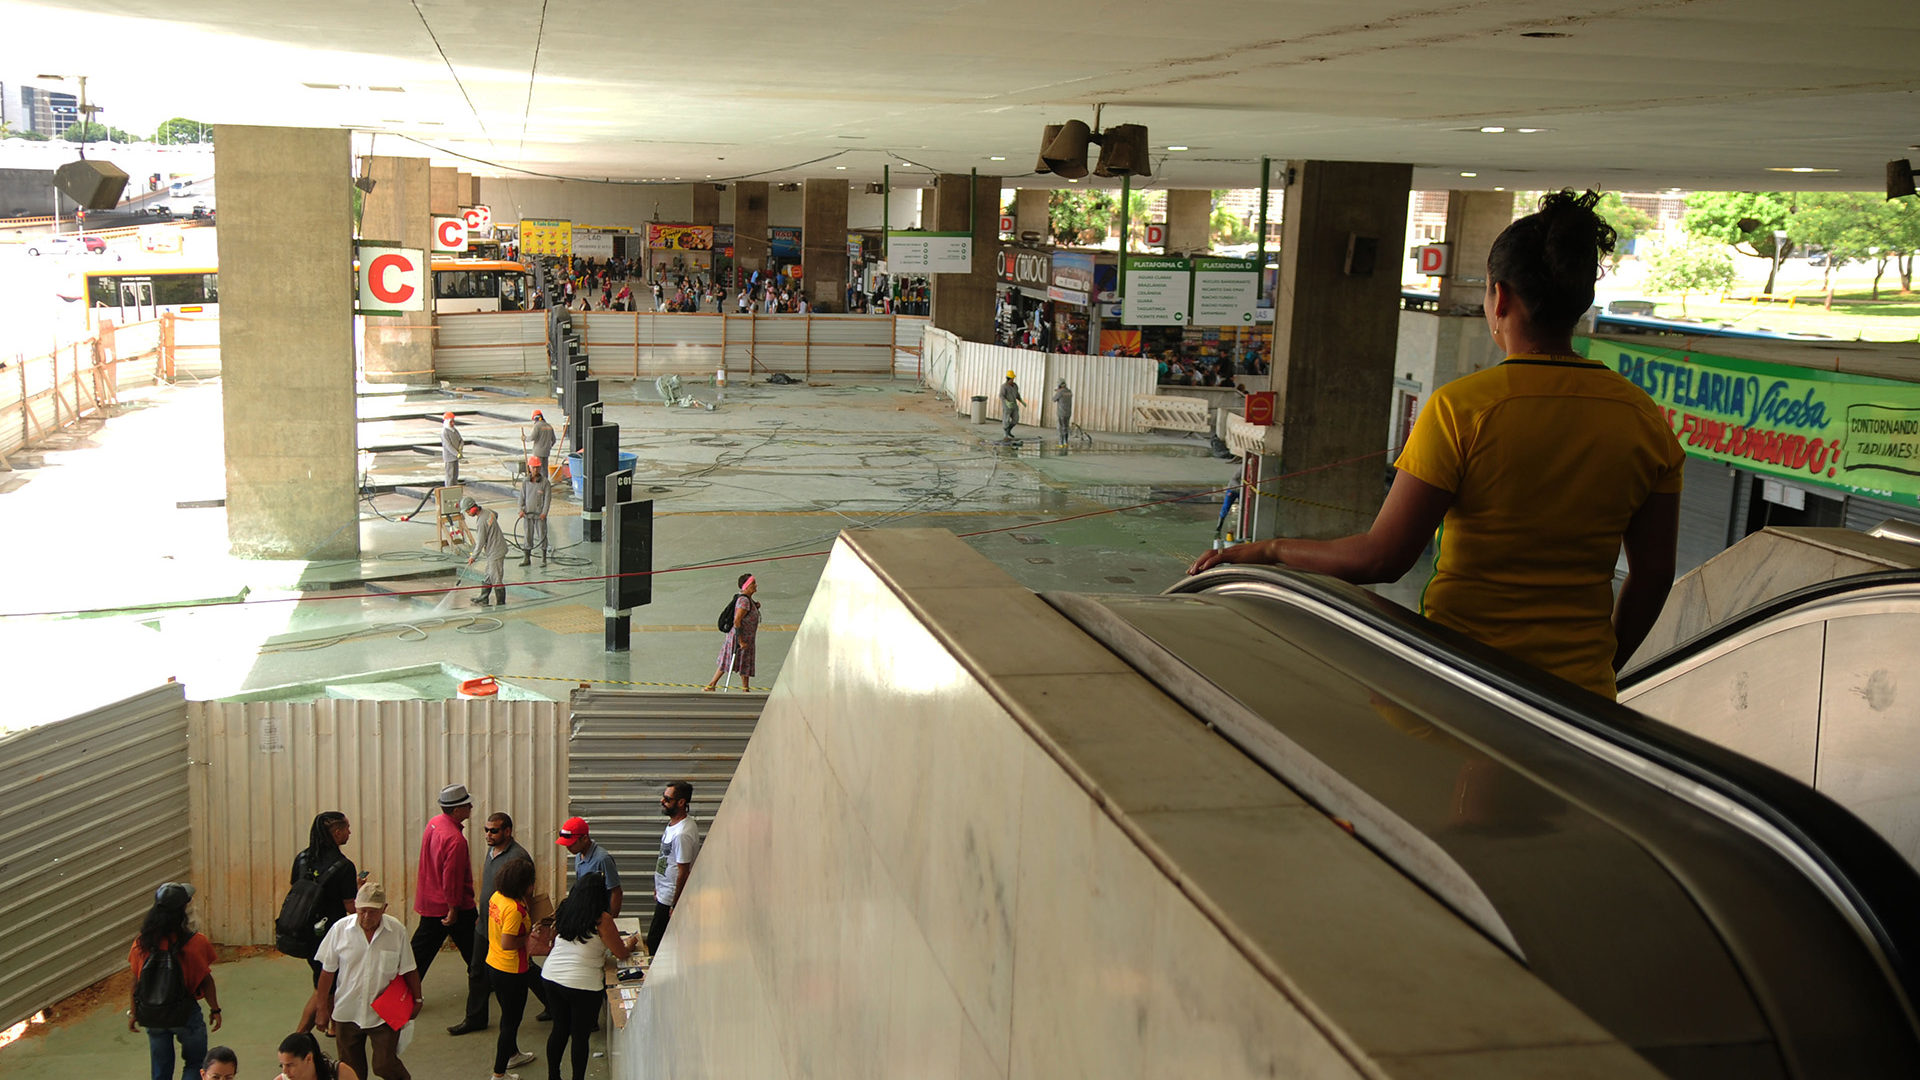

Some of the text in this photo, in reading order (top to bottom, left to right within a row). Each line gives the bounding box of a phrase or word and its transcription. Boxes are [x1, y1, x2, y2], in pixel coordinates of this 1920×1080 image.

[464, 211, 480, 228] C
[1001, 218, 1012, 230] D
[438, 221, 463, 247] C
[1148, 226, 1162, 243] D
[997, 251, 1006, 276] O
[1422, 248, 1443, 272] D
[368, 254, 415, 303] C
[1618, 353, 1745, 418] PASTELARIA
[1851, 417, 1919, 435] CONTORNANDO
[1677, 413, 1841, 478] FUNCIONANDO!
[1857, 442, 1920, 460] TAPUMES!
[617, 476, 632, 486] C 01
